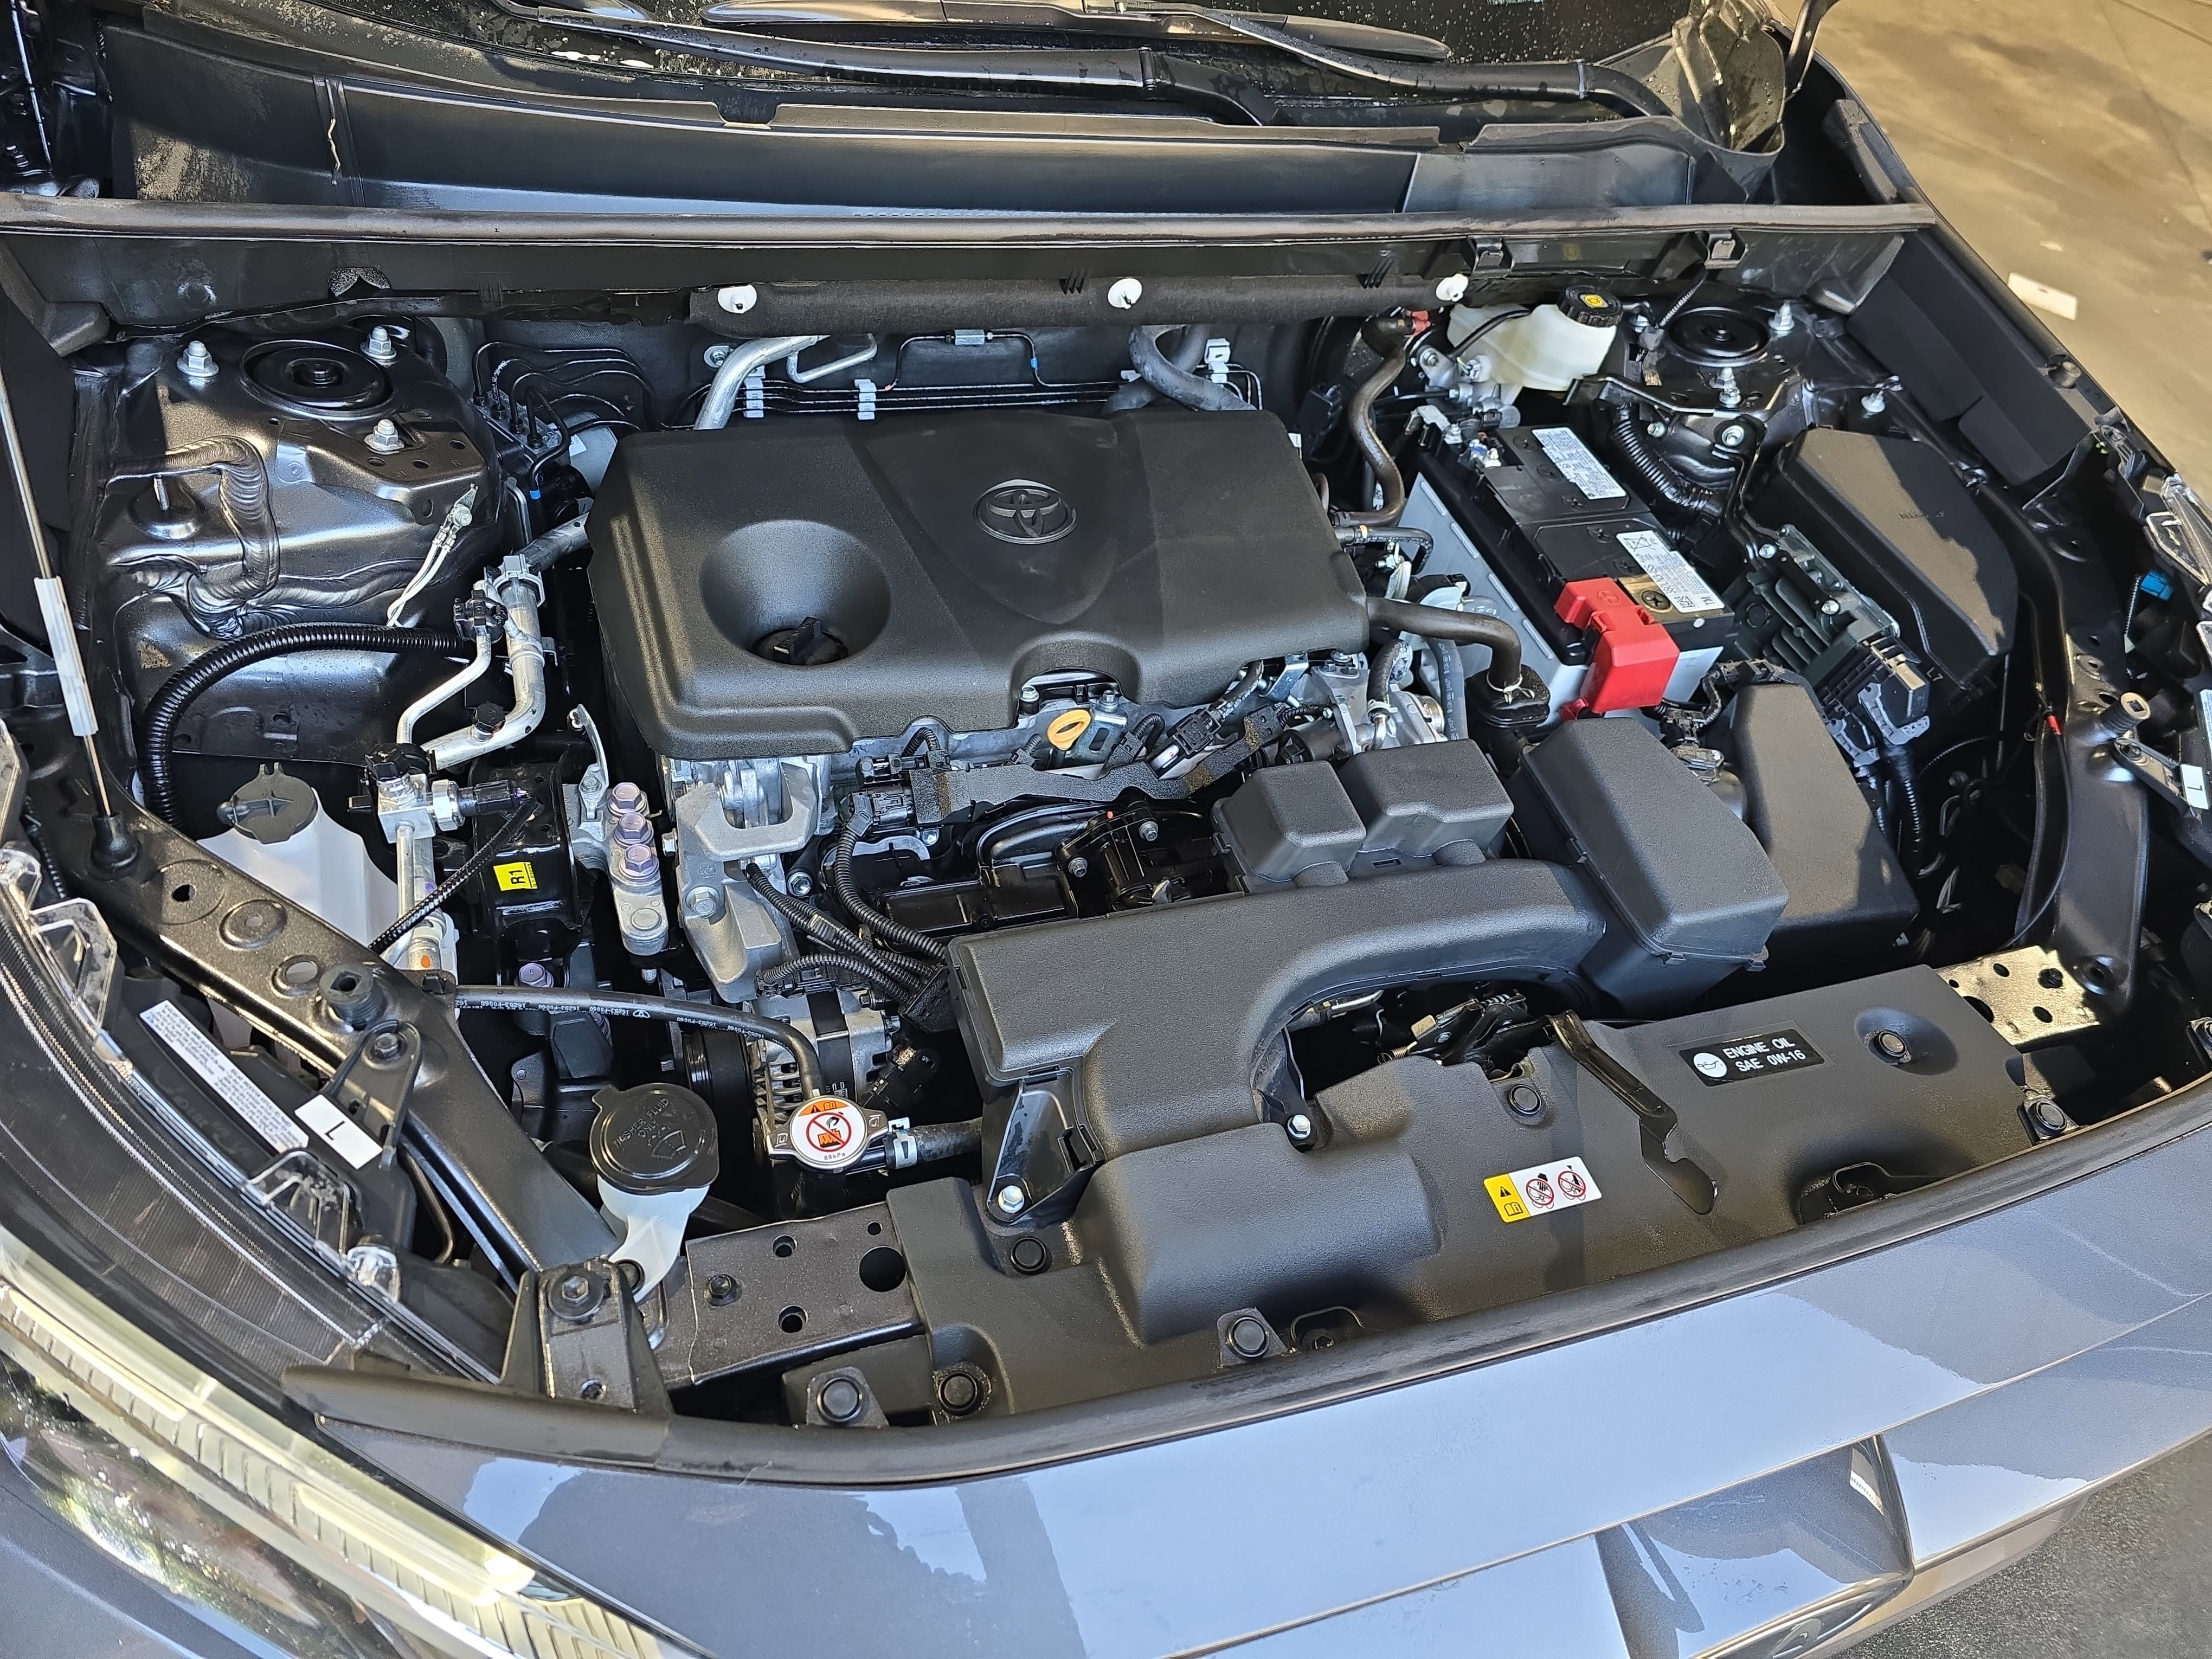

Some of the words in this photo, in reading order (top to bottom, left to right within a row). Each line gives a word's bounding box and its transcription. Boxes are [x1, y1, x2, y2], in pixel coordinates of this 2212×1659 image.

[1700, 596, 1716, 605] TM
[508, 870, 526, 884] R1
[1722, 1041, 1770, 1059] ENGINE
[1772, 1037, 1796, 1049] OIL
[1735, 1058, 1764, 1071] SAE
[1766, 1050, 1805, 1065] 0W-16
[325, 1121, 345, 1140] L
[612, 1118, 646, 1148] WASHER
[647, 1098, 669, 1119] FLUID
[638, 1119, 659, 1137] ONLY
